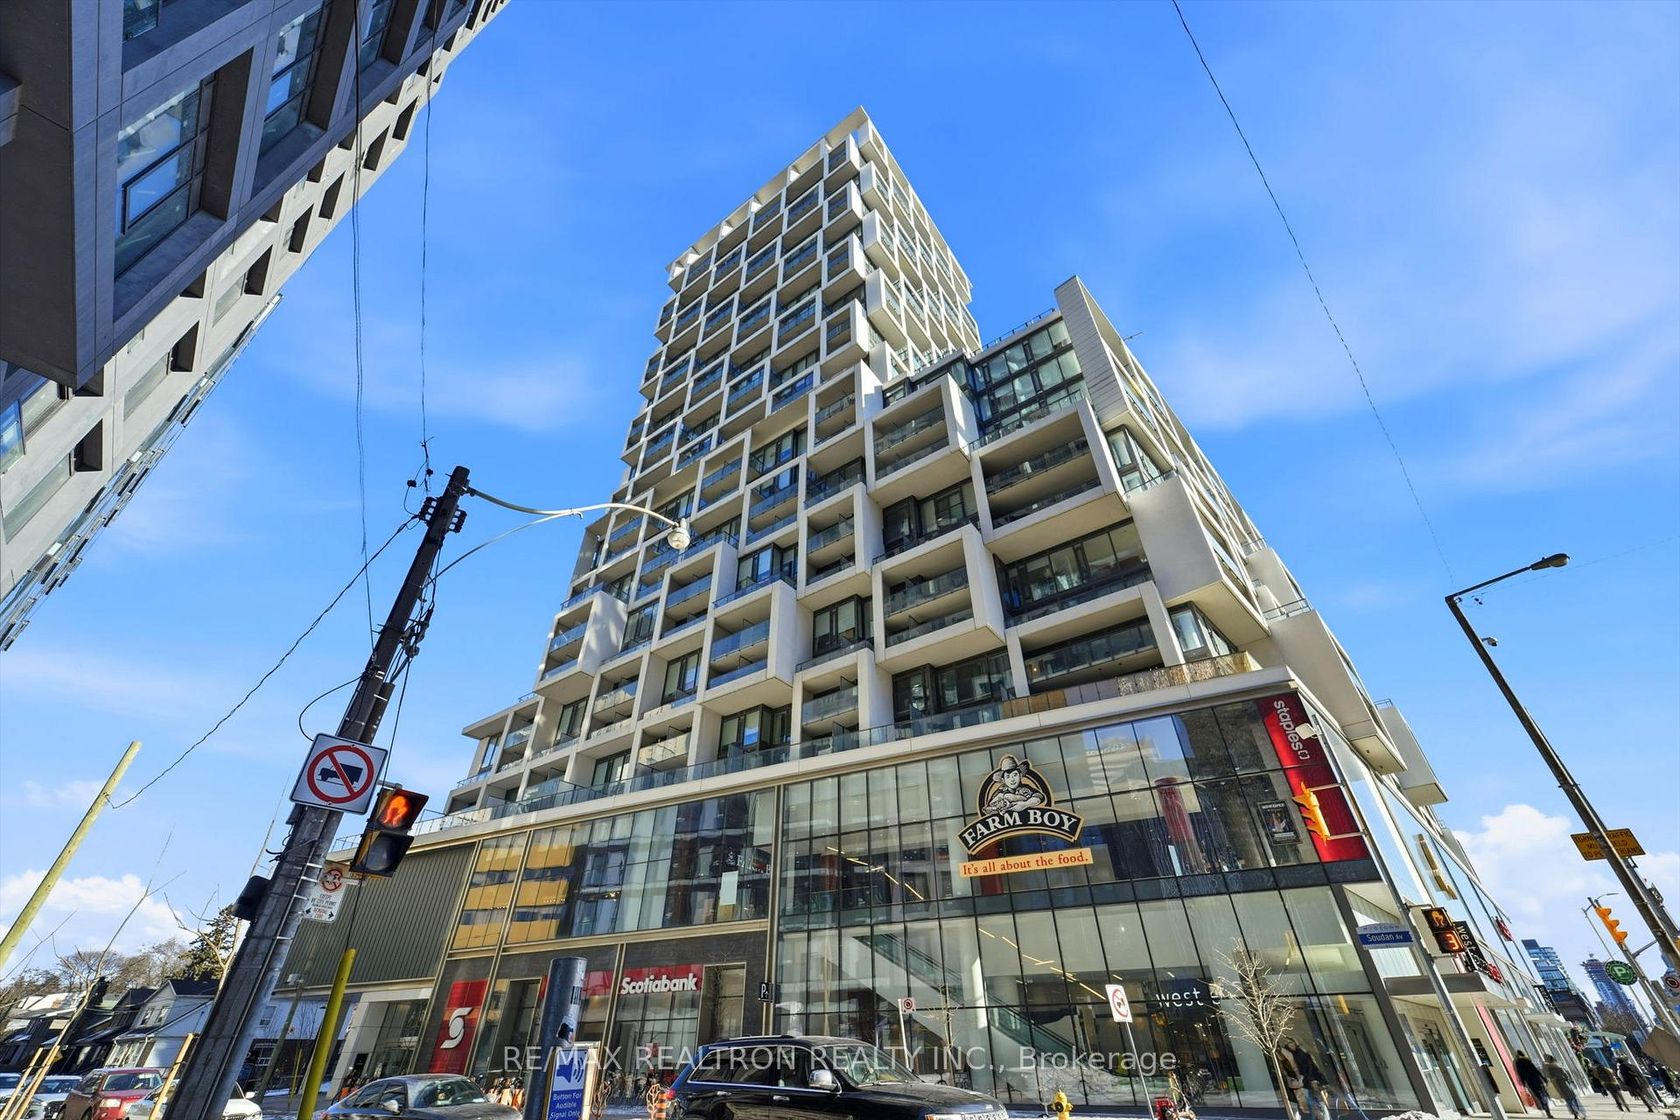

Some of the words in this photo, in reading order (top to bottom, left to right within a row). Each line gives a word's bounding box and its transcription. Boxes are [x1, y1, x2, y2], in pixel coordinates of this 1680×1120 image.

[1274, 700, 1303, 751] staples
[962, 811, 1022, 846] FARM
[1028, 809, 1078, 832] BOY
[963, 864, 979, 876] It's
[982, 862, 996, 873] all
[1000, 860, 1031, 871] about
[1036, 857, 1054, 867] the
[1058, 852, 1088, 865] food.
[1366, 933, 1395, 942] Soudan
[1445, 933, 1459, 950] 3
[1457, 926, 1476, 952] west
[1613, 966, 1626, 977] P
[620, 973, 698, 995] Scotiabank
[1156, 988, 1204, 1008] west
[553, 1093, 572, 1101] Button
[550, 1111, 567, 1120] Signal
